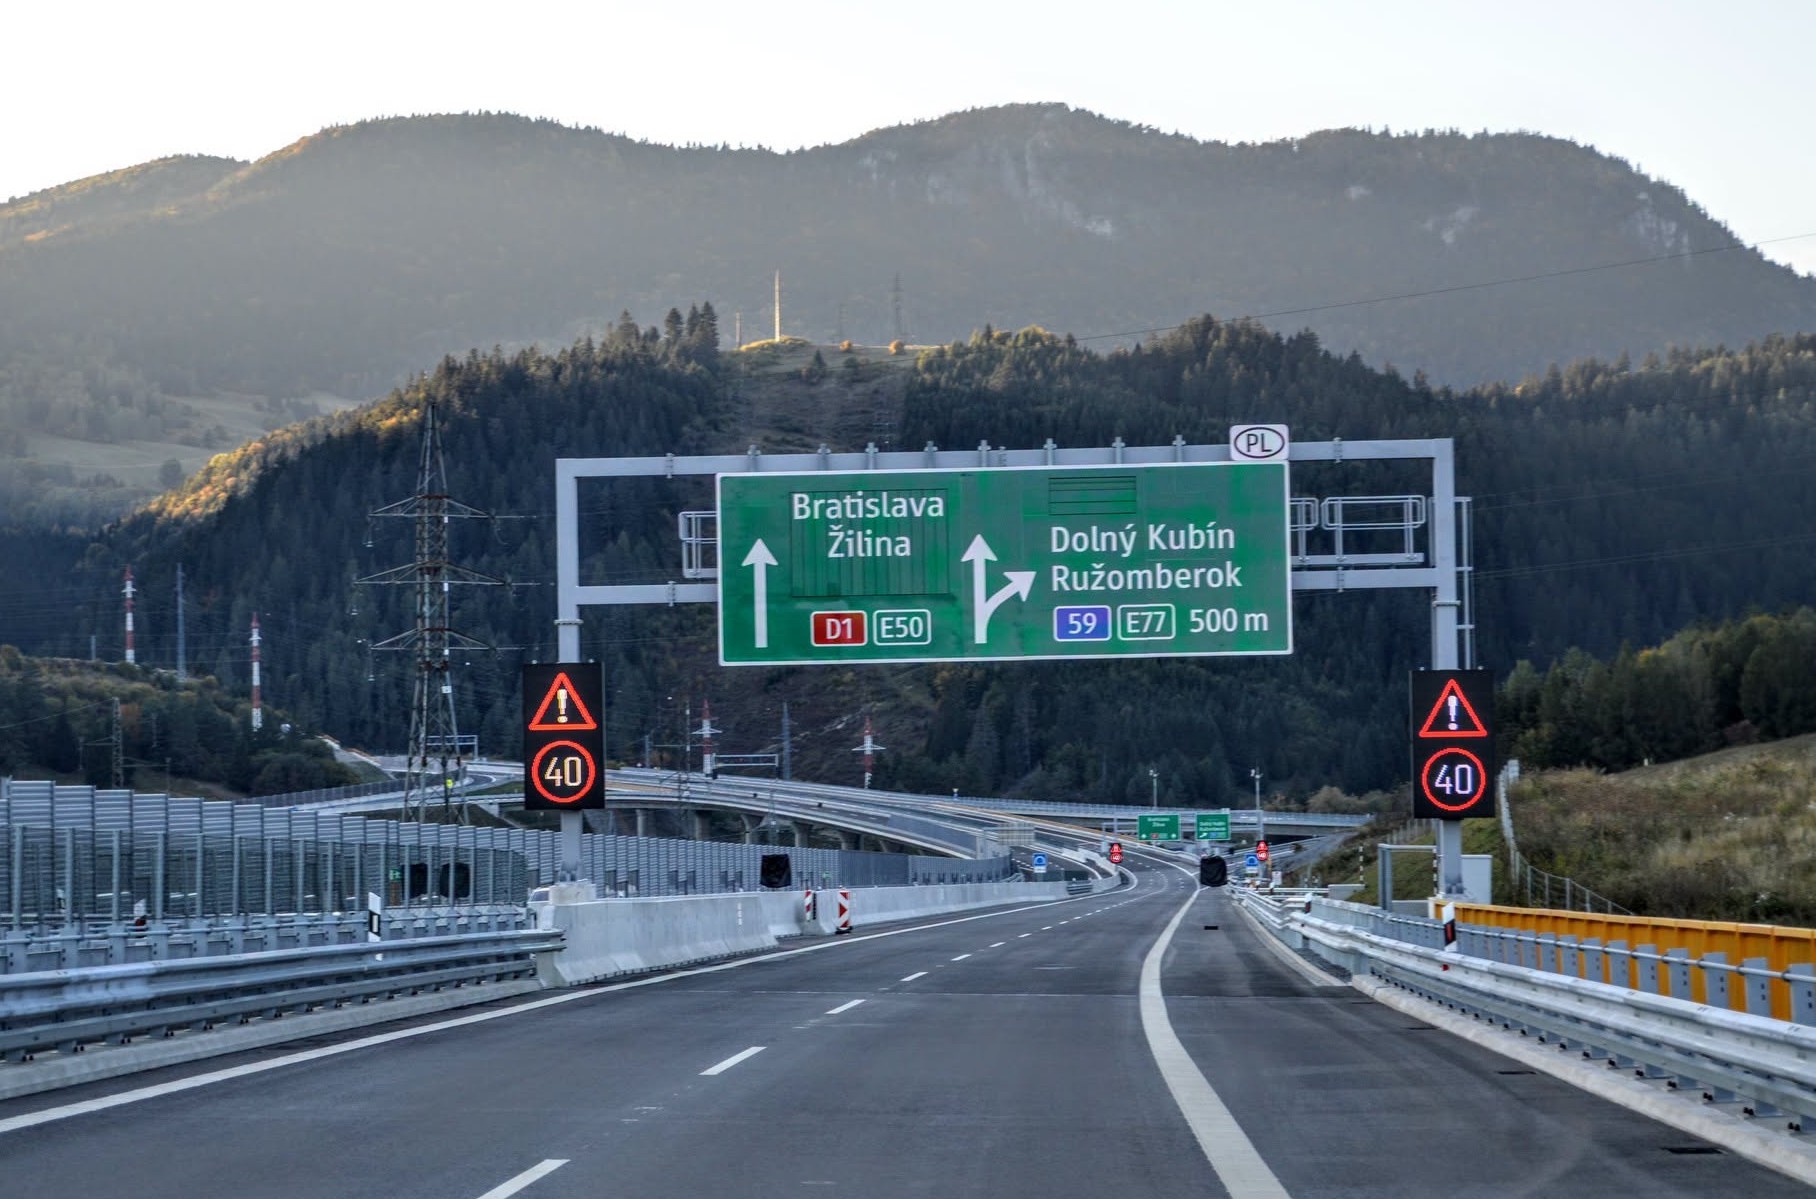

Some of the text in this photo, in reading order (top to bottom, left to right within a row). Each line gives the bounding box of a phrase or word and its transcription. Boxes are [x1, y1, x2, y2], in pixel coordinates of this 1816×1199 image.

[1247, 434, 1270, 453] PL
[792, 490, 944, 520] Bratislava
[828, 525, 911, 558] Žilina
[1051, 521, 1235, 558] Dolný Kubín
[1052, 561, 1242, 592] Ružomberok
[825, 617, 923, 641] D1 E50
[1068, 608, 1269, 634] 59 E77 500 m
[544, 756, 582, 787] 40
[1434, 764, 1473, 795] 40
